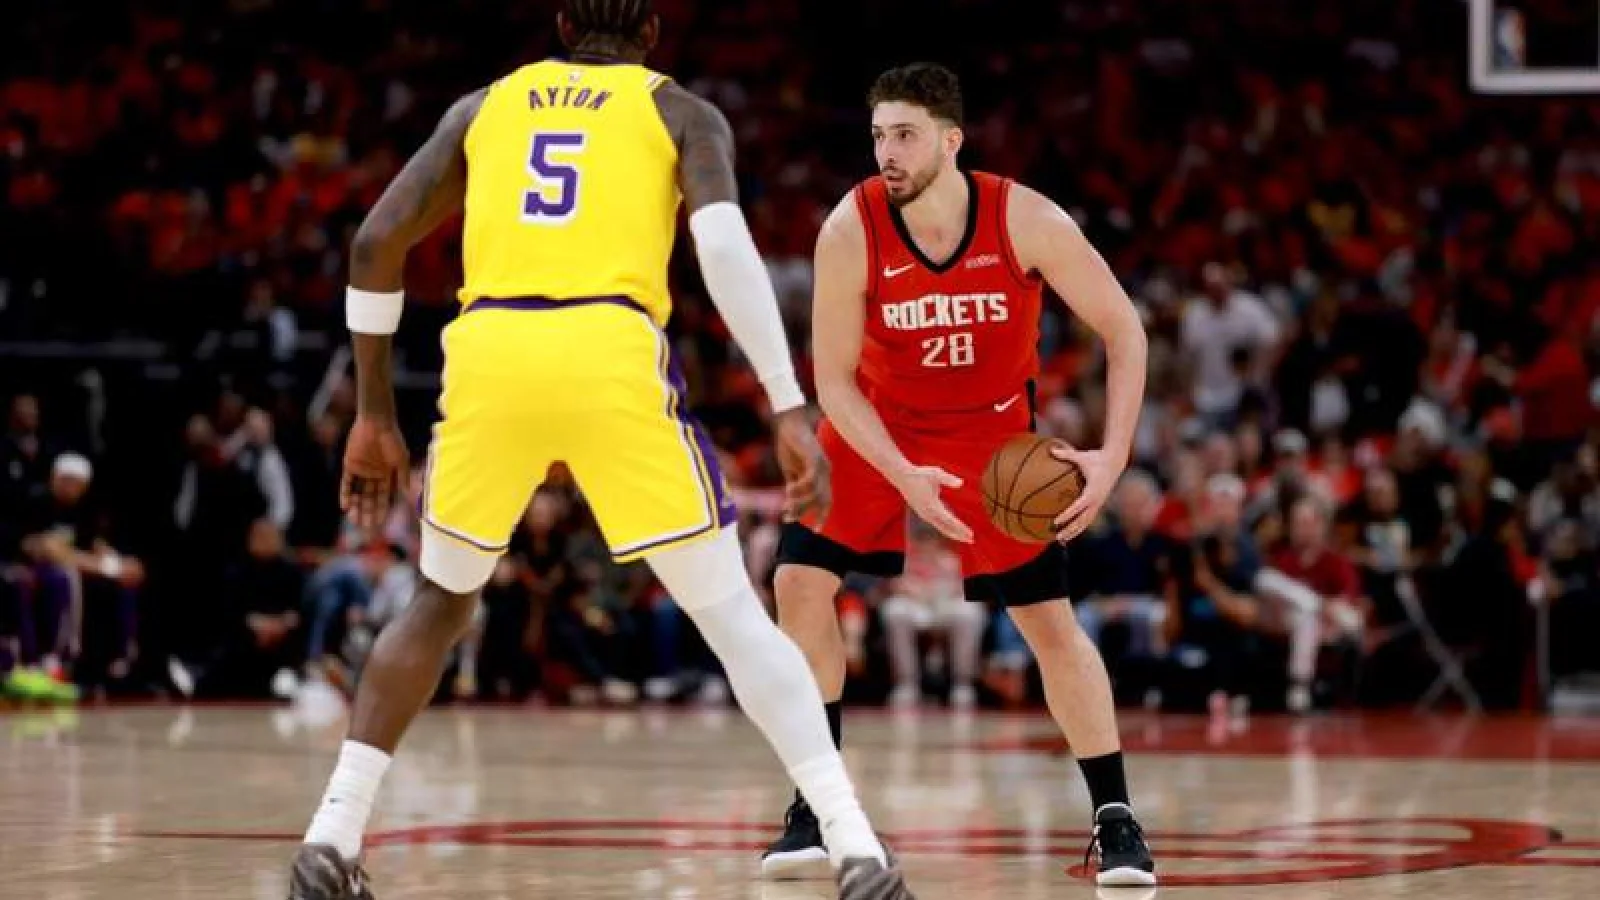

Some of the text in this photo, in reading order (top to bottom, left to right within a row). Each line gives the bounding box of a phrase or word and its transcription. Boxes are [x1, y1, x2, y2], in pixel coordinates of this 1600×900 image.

[528, 86, 612, 110] AYTON
[522, 132, 585, 219] 5
[881, 292, 1009, 330] ROCKETS
[920, 332, 975, 367] 28
